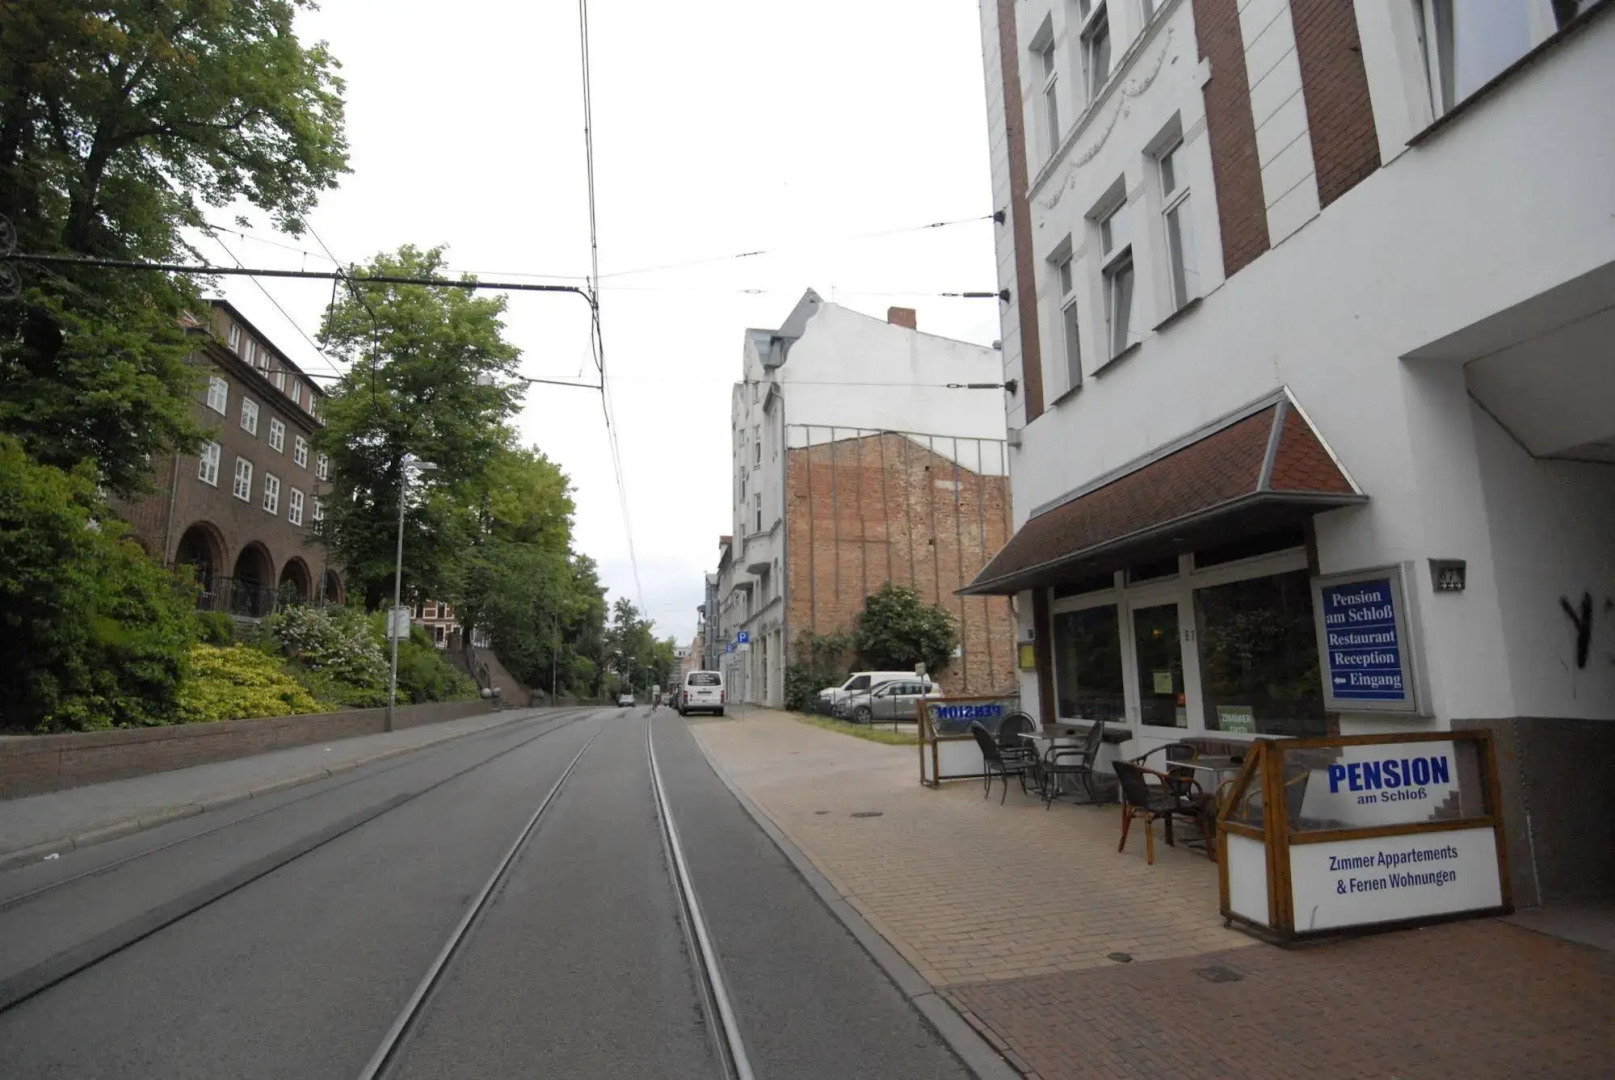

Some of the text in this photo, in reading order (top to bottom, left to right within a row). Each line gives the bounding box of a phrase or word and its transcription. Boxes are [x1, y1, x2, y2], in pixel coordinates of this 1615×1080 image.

[1332, 590, 1382, 607] Pension
[1326, 604, 1393, 624] am Schloß
[739, 632, 747, 642] P
[1329, 630, 1395, 646] Restaurant
[1334, 651, 1395, 667] Reception
[1350, 672, 1402, 689] Eingang
[1221, 714, 1251, 723] ZIMMER
[1328, 756, 1450, 794] PENSION
[1357, 787, 1427, 805] am Schloß
[1329, 844, 1459, 871] Zimmer Appartements
[1336, 870, 1456, 894] & Ferien Wohnungen
